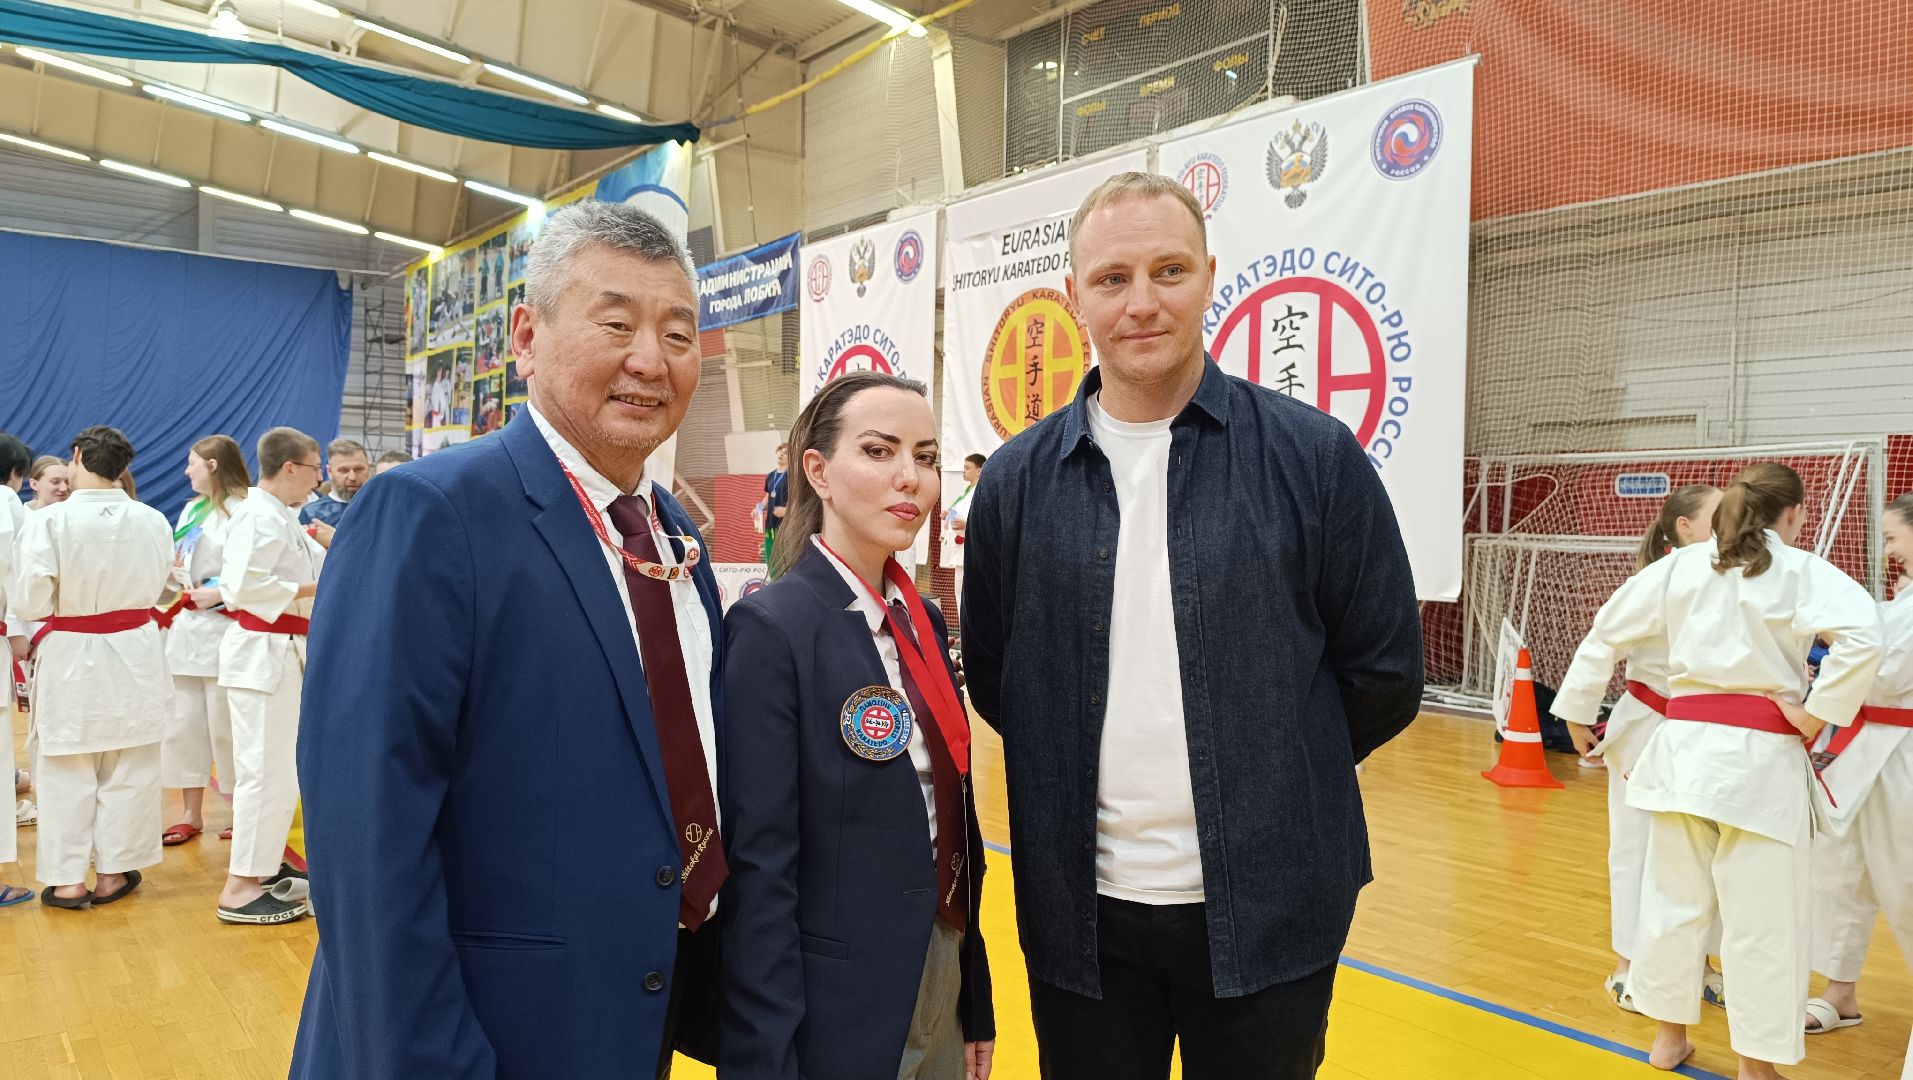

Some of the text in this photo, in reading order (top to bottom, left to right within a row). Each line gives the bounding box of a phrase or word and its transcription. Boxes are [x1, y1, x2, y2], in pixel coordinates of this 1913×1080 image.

[1001, 252, 1061, 282] KARATEDO
[1062, 250, 1073, 269] F
[709, 294, 743, 315] ГОРОДА
[1203, 247, 1315, 336] КАРАТЭДО
[1323, 251, 1412, 363] СИТО-РЮ
[817, 324, 907, 381] КАРАТЭДО СИТО-Р
[986, 297, 1026, 364] SHITORYU
[983, 376, 1012, 438] URASIAN
[855, 728, 888, 748] KARATEDO
[260, 910, 295, 923] crocs
